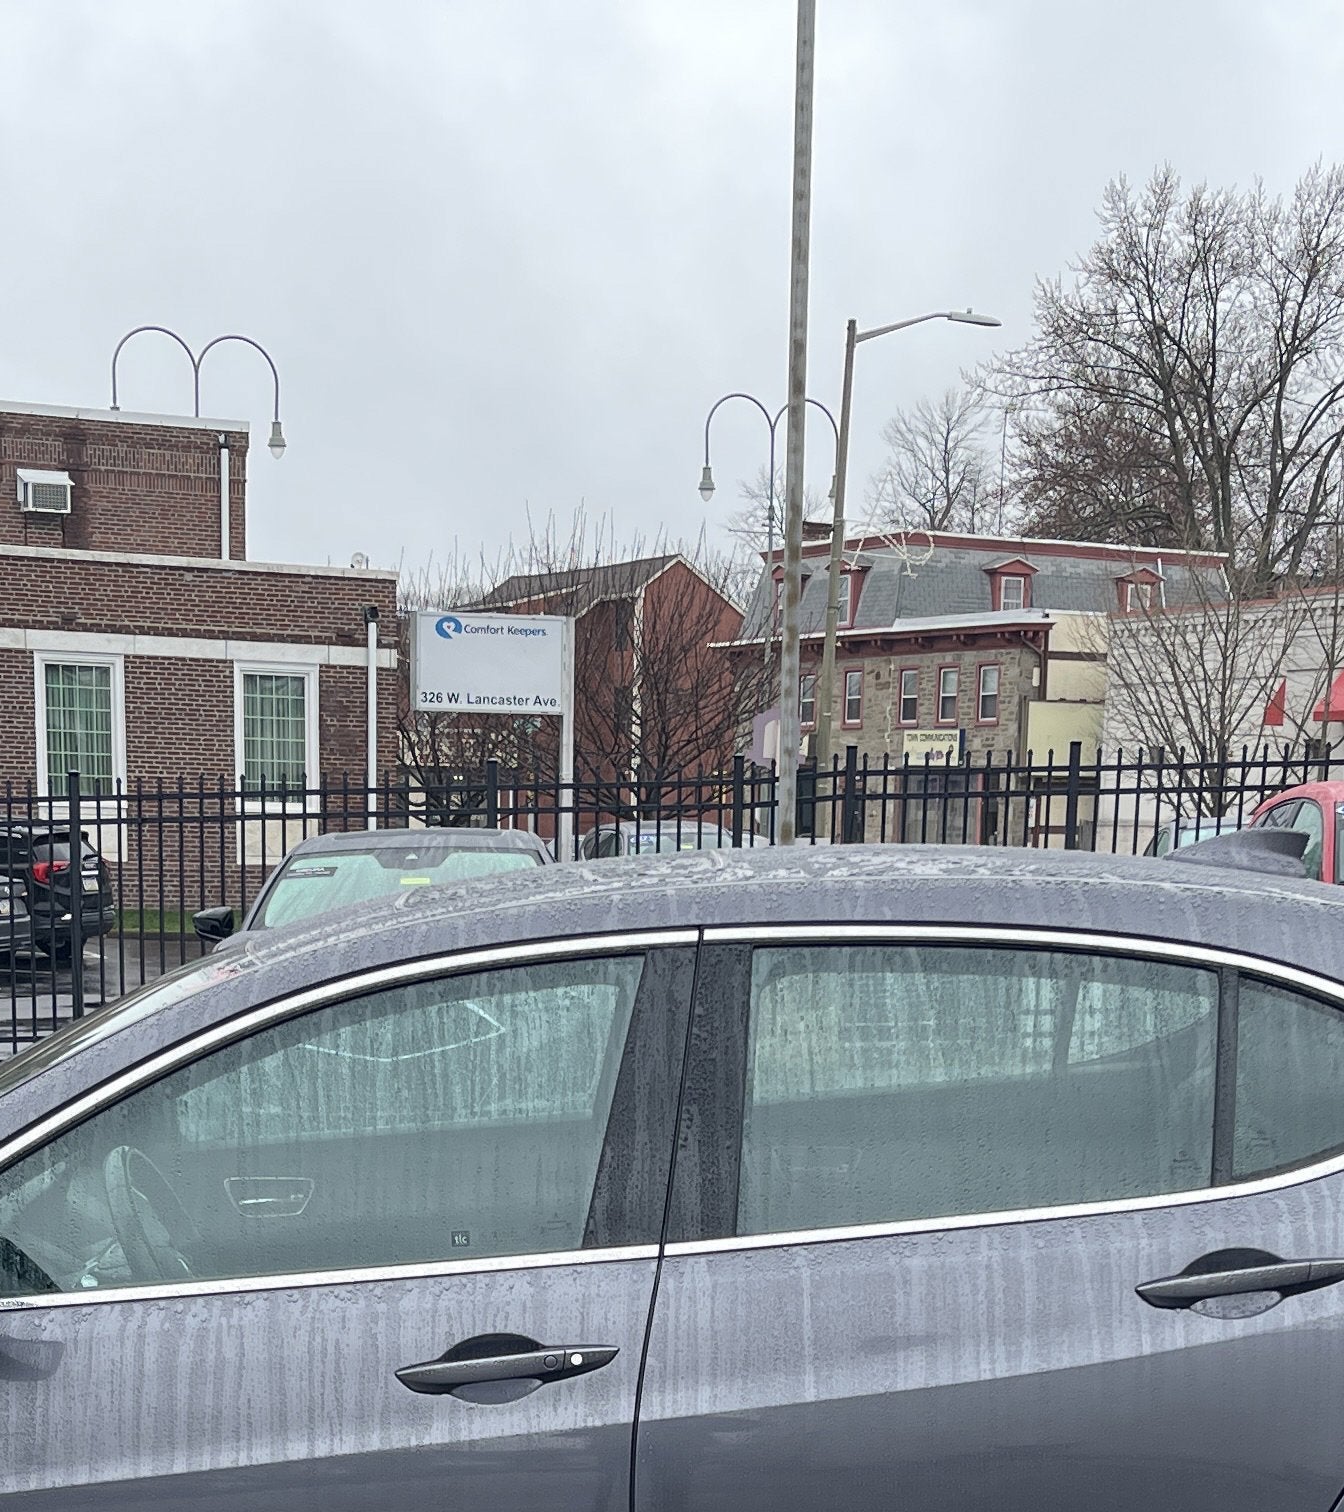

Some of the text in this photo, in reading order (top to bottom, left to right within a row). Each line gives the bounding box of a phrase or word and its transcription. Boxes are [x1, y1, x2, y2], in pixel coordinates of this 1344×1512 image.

[464, 624, 504, 635] Comfort
[420, 691, 443, 704] 326
[466, 693, 530, 706] Lancaster
